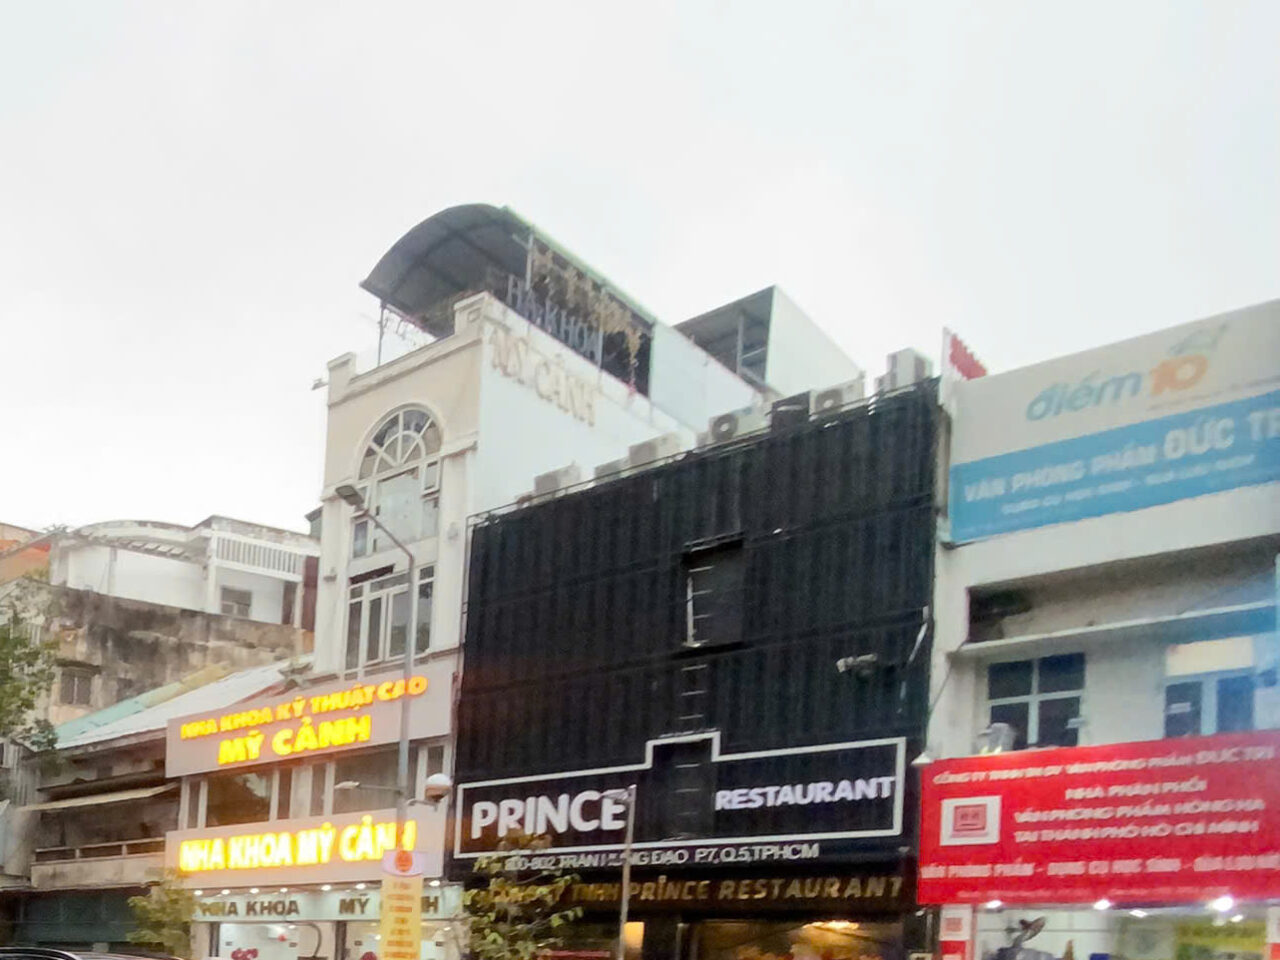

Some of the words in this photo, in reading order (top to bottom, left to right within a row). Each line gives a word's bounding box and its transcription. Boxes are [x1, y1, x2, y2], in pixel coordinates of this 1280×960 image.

[220, 706, 274, 733] KHOA
[217, 729, 265, 765] MỸ
[272, 715, 372, 756] CẢNH
[714, 775, 896, 812] RESTAURANT
[471, 788, 628, 840] PRINCE
[179, 837, 226, 873] NHA
[226, 831, 295, 870] KHOA
[720, 876, 902, 900] RESTAURANT
[245, 899, 300, 917] KHOA
